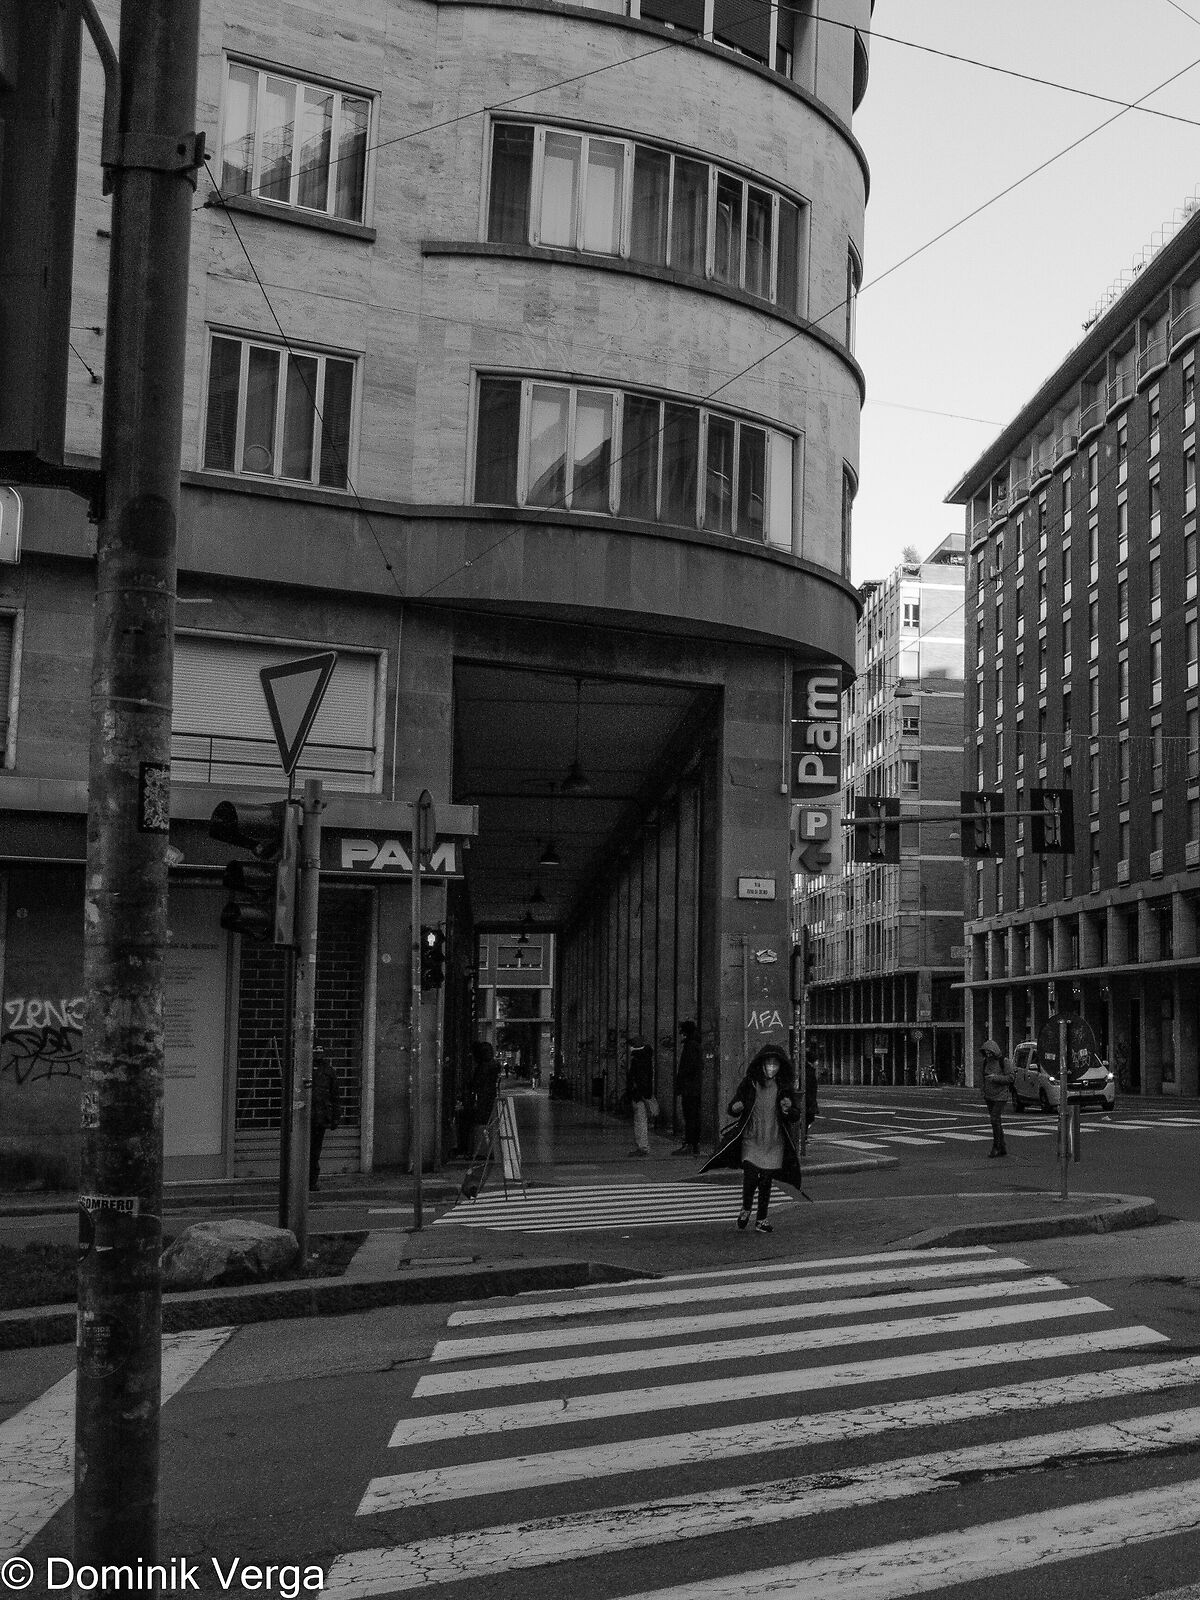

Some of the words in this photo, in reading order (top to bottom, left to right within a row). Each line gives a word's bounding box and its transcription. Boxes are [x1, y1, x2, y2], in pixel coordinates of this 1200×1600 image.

[798, 677, 838, 784] Pam
[806, 811, 828, 837] P
[341, 838, 456, 872] PAM
